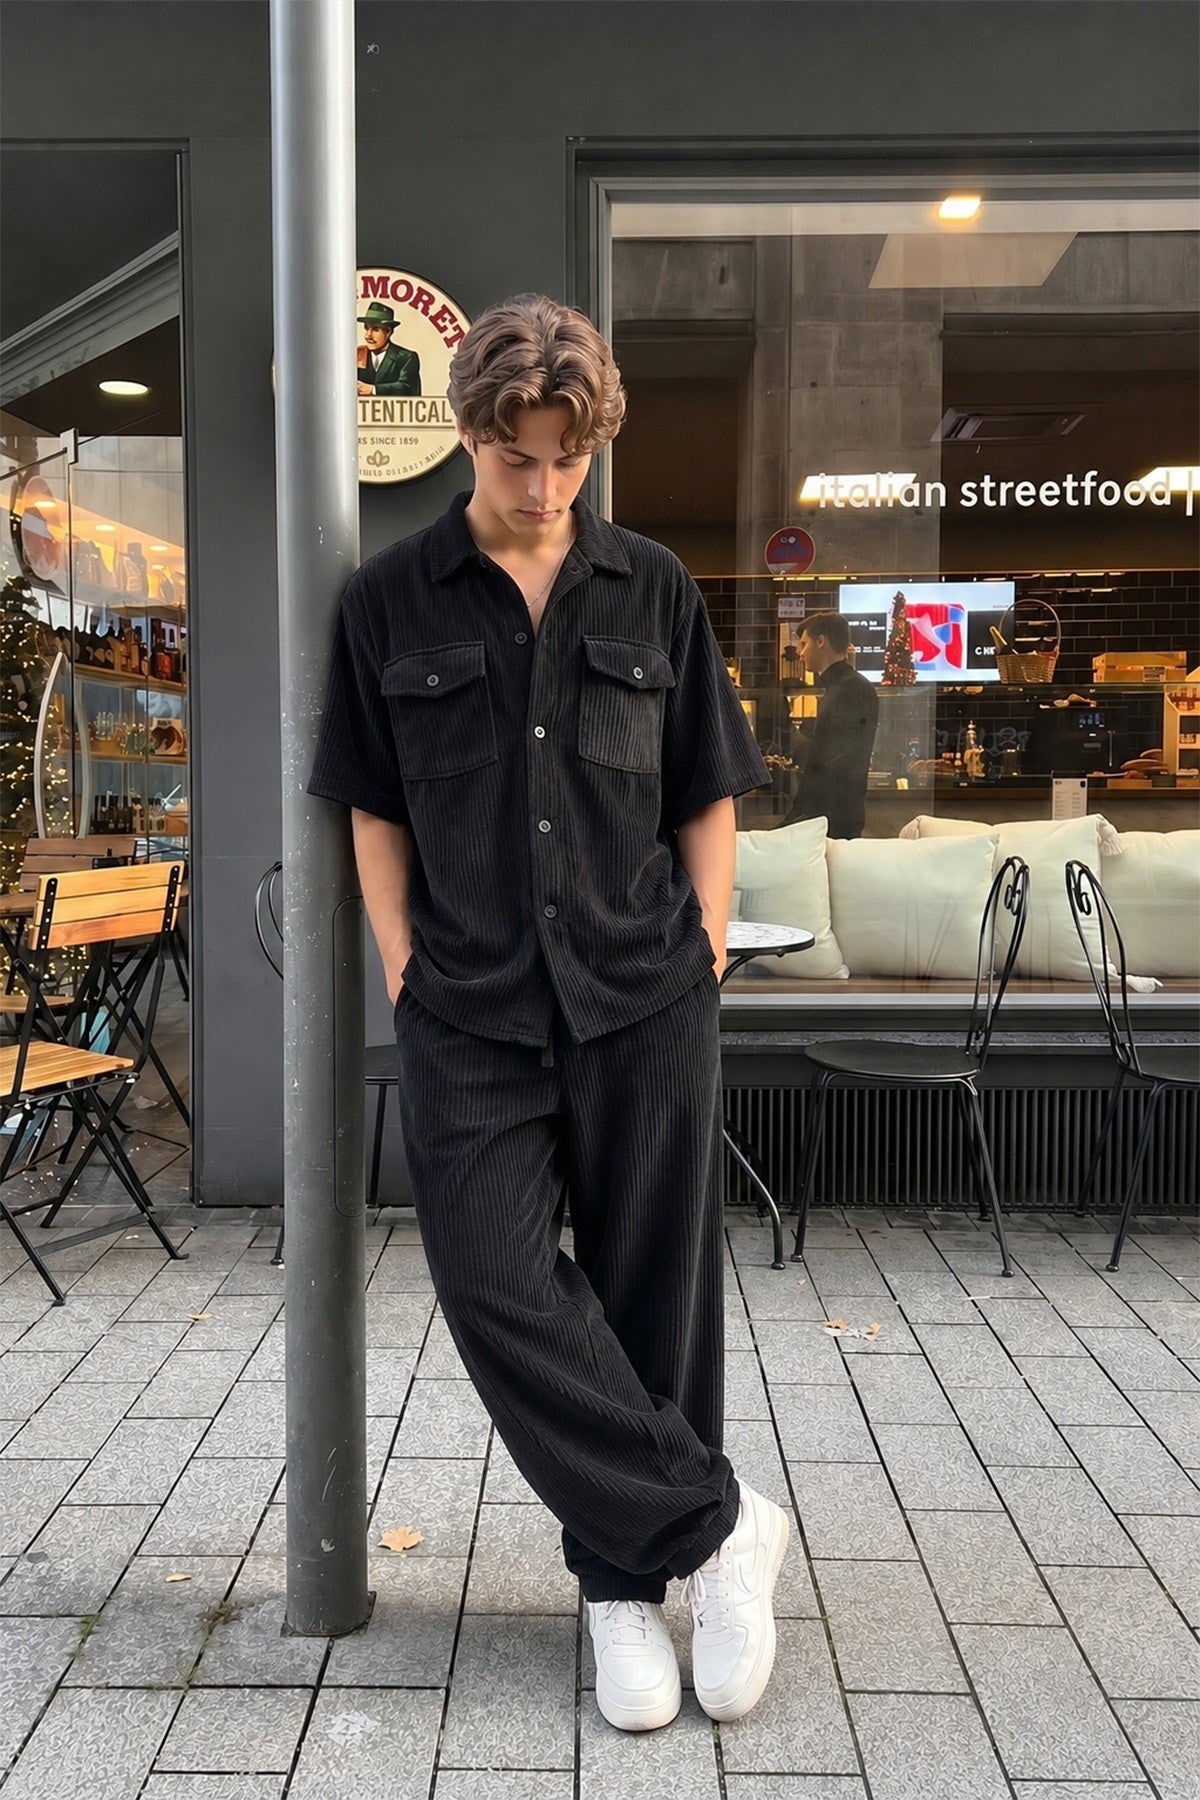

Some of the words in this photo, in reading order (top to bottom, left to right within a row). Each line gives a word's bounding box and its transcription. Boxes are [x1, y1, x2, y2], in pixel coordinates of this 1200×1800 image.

[358, 399, 453, 423] TENTICAL
[370, 436, 397, 445] SINCE
[399, 436, 419, 445] 1859
[819, 471, 946, 508] italian
[959, 470, 1171, 506] streetfood
